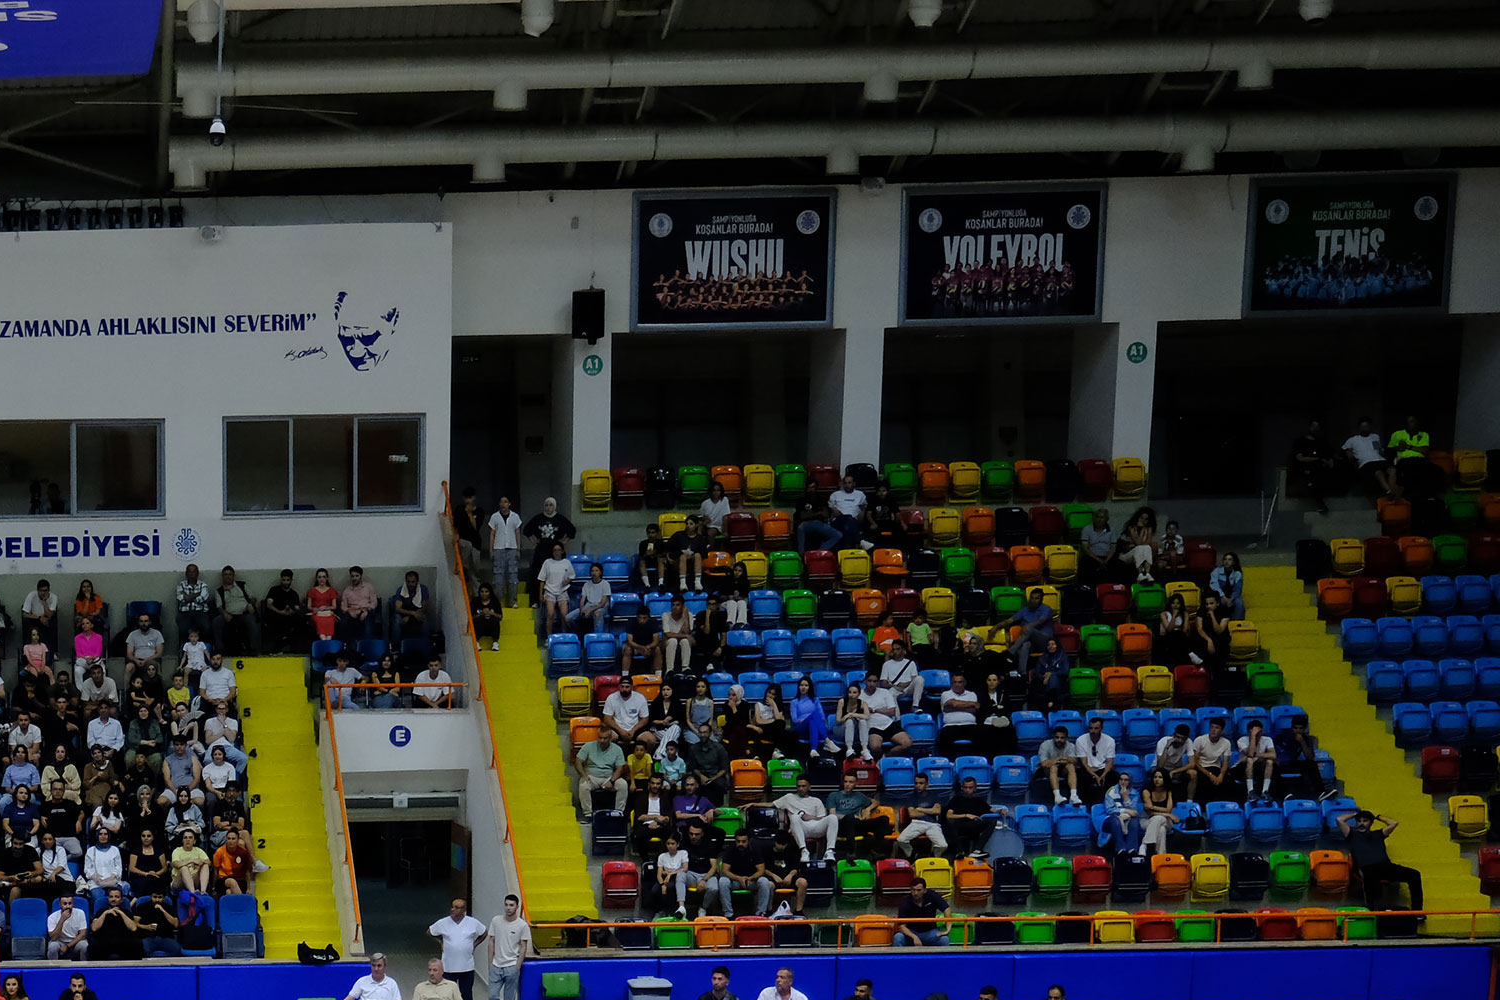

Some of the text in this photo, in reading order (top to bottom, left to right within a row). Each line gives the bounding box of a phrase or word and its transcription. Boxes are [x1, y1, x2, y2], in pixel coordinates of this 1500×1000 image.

[964, 216, 1044, 230] KOŞANLAR BURADA!
[695, 223, 738, 235] KOŞANLAR
[684, 238, 785, 281] WUSHU
[0, 318, 92, 339] ZAMANDA
[96, 315, 217, 337] AHLAKLISINI
[1130, 344, 1144, 357] A1
[585, 358, 599, 369] A1
[236, 660, 244, 670] 6
[243, 707, 251, 717] 5
[395, 729, 406, 742] E
[249, 748, 257, 758] 4
[257, 838, 266, 849] 2
[262, 900, 270, 911] 1
